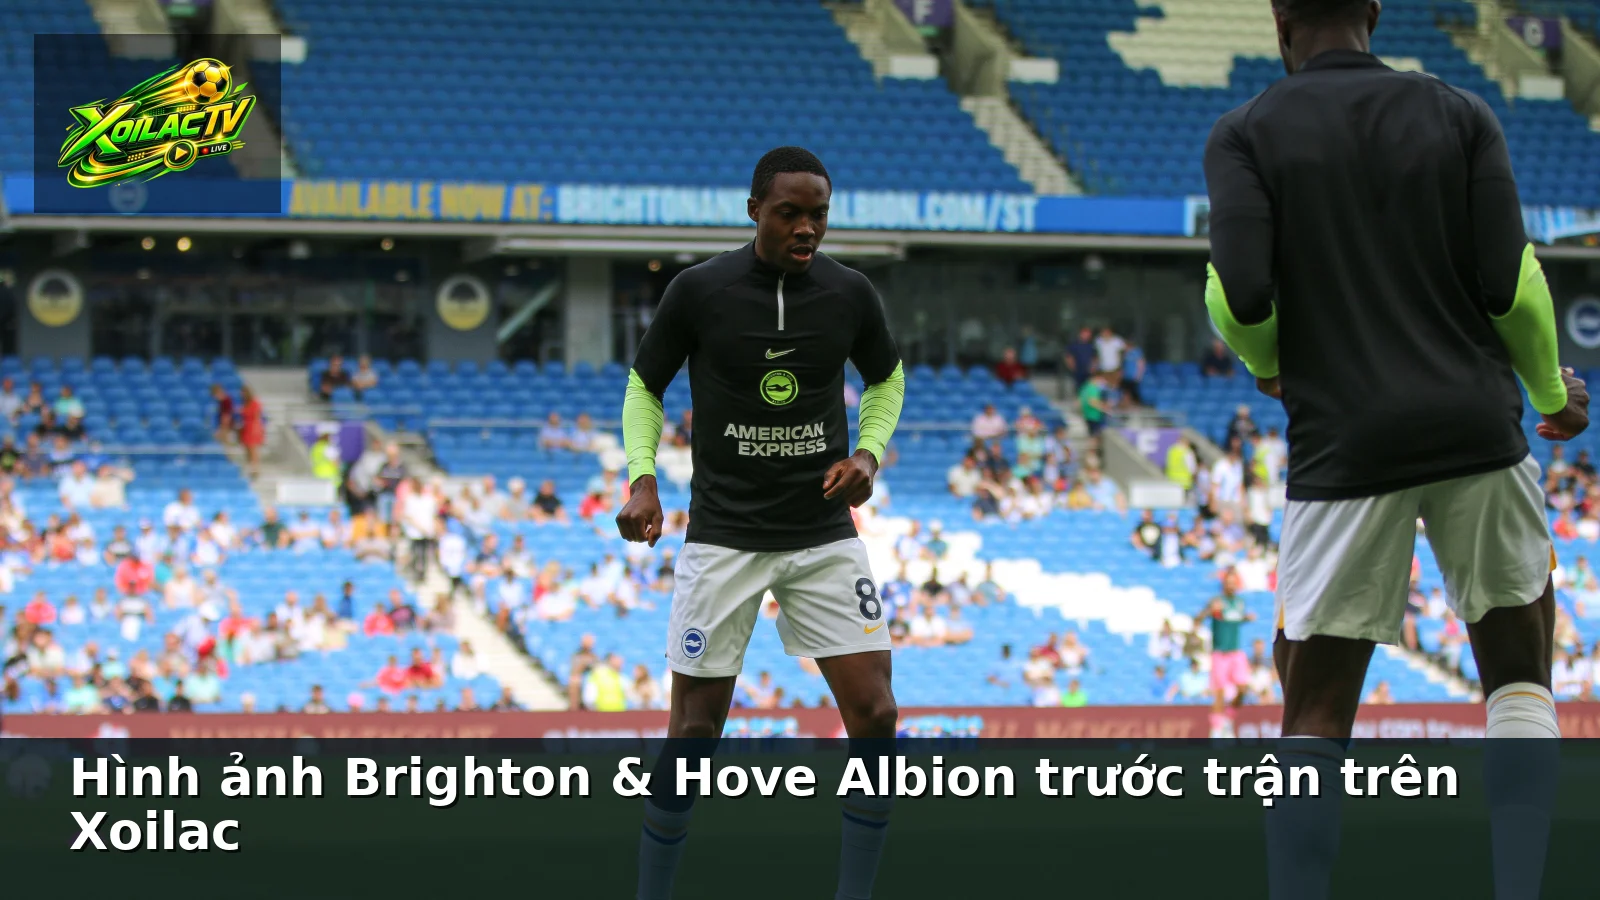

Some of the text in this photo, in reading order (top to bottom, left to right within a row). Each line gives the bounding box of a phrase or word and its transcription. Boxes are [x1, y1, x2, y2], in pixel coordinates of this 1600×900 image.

[289, 181, 435, 219] AVAILABLE
[439, 183, 505, 218] NOW
[509, 184, 553, 219] AT:
[723, 422, 824, 441] AMERICAN
[738, 437, 827, 457] EXPRESS
[855, 577, 882, 621] 8
